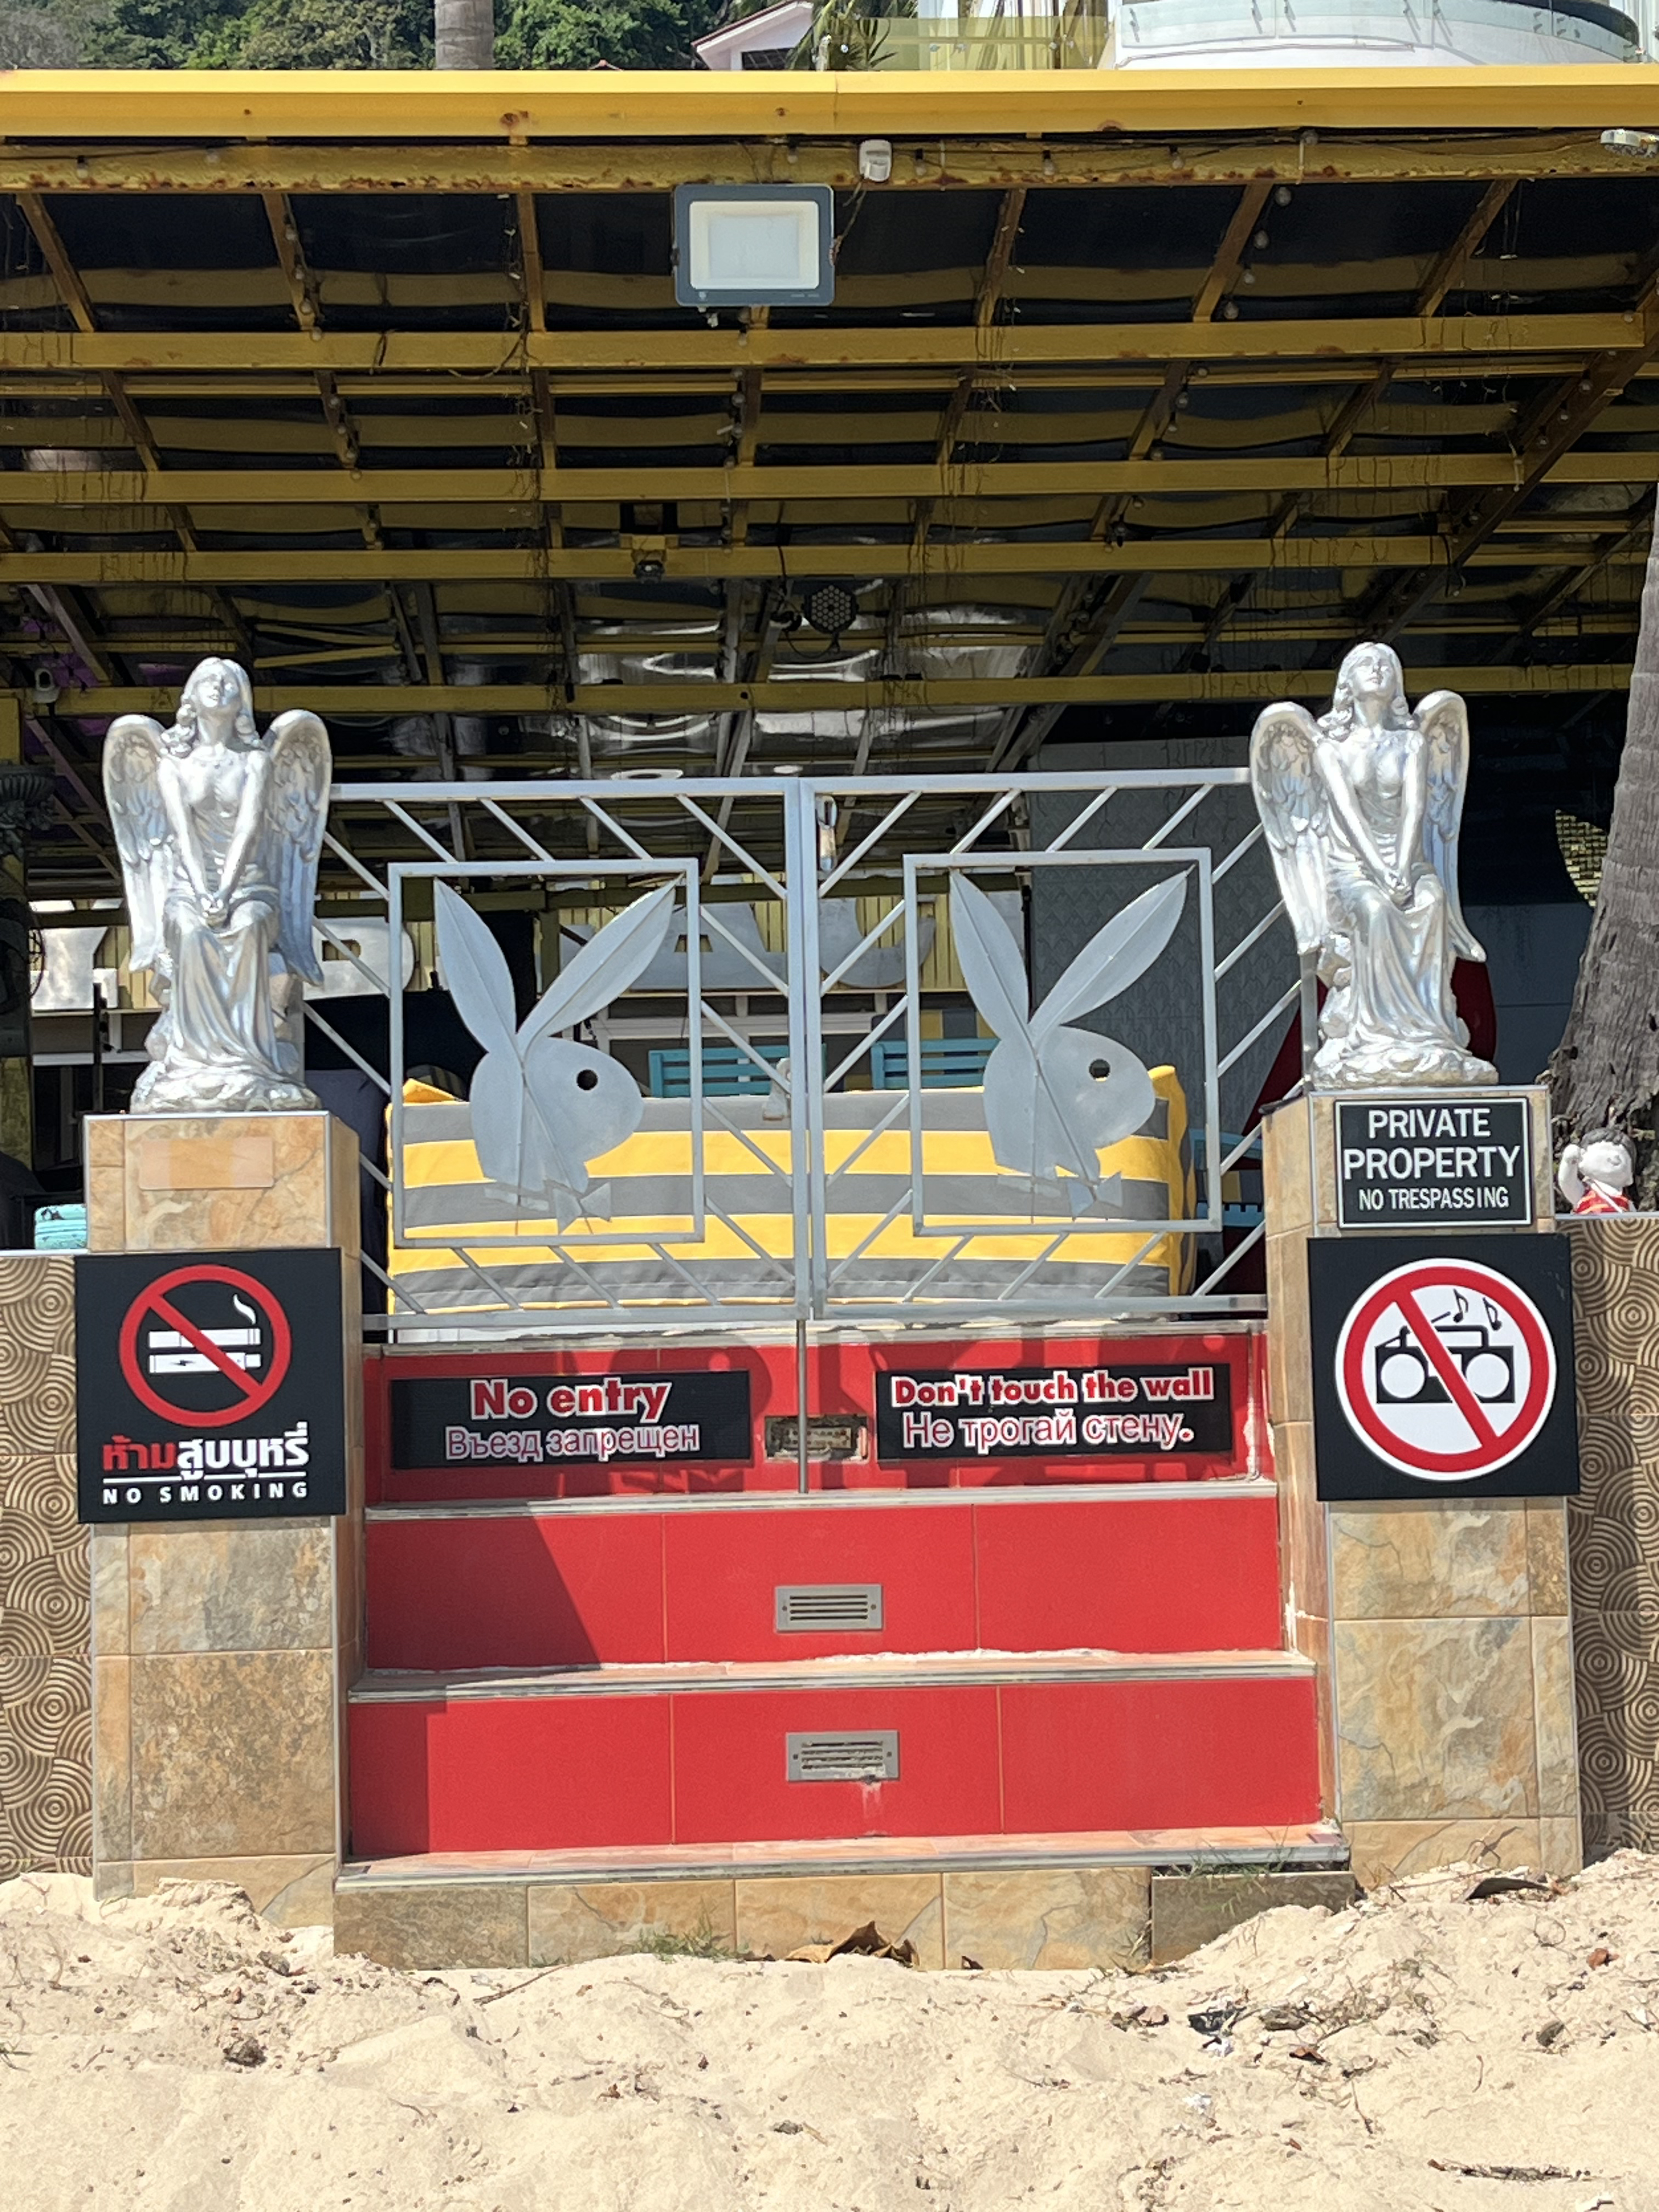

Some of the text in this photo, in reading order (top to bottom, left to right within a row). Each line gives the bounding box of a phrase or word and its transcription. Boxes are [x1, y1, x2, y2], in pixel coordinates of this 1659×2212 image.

[1368, 1108, 1491, 1138] PRIVATE
[1344, 1146, 1520, 1180] PROPERTY
[1358, 1186, 1509, 1211] NO TRESPASSING
[470, 1377, 672, 1424] No entry
[891, 1367, 1214, 1407] Don't touch the wall
[445, 1424, 700, 1463] Въезд запрещен
[902, 1408, 1195, 1455] Не трогай стену.
[103, 1481, 307, 1505] NO SMOKING
